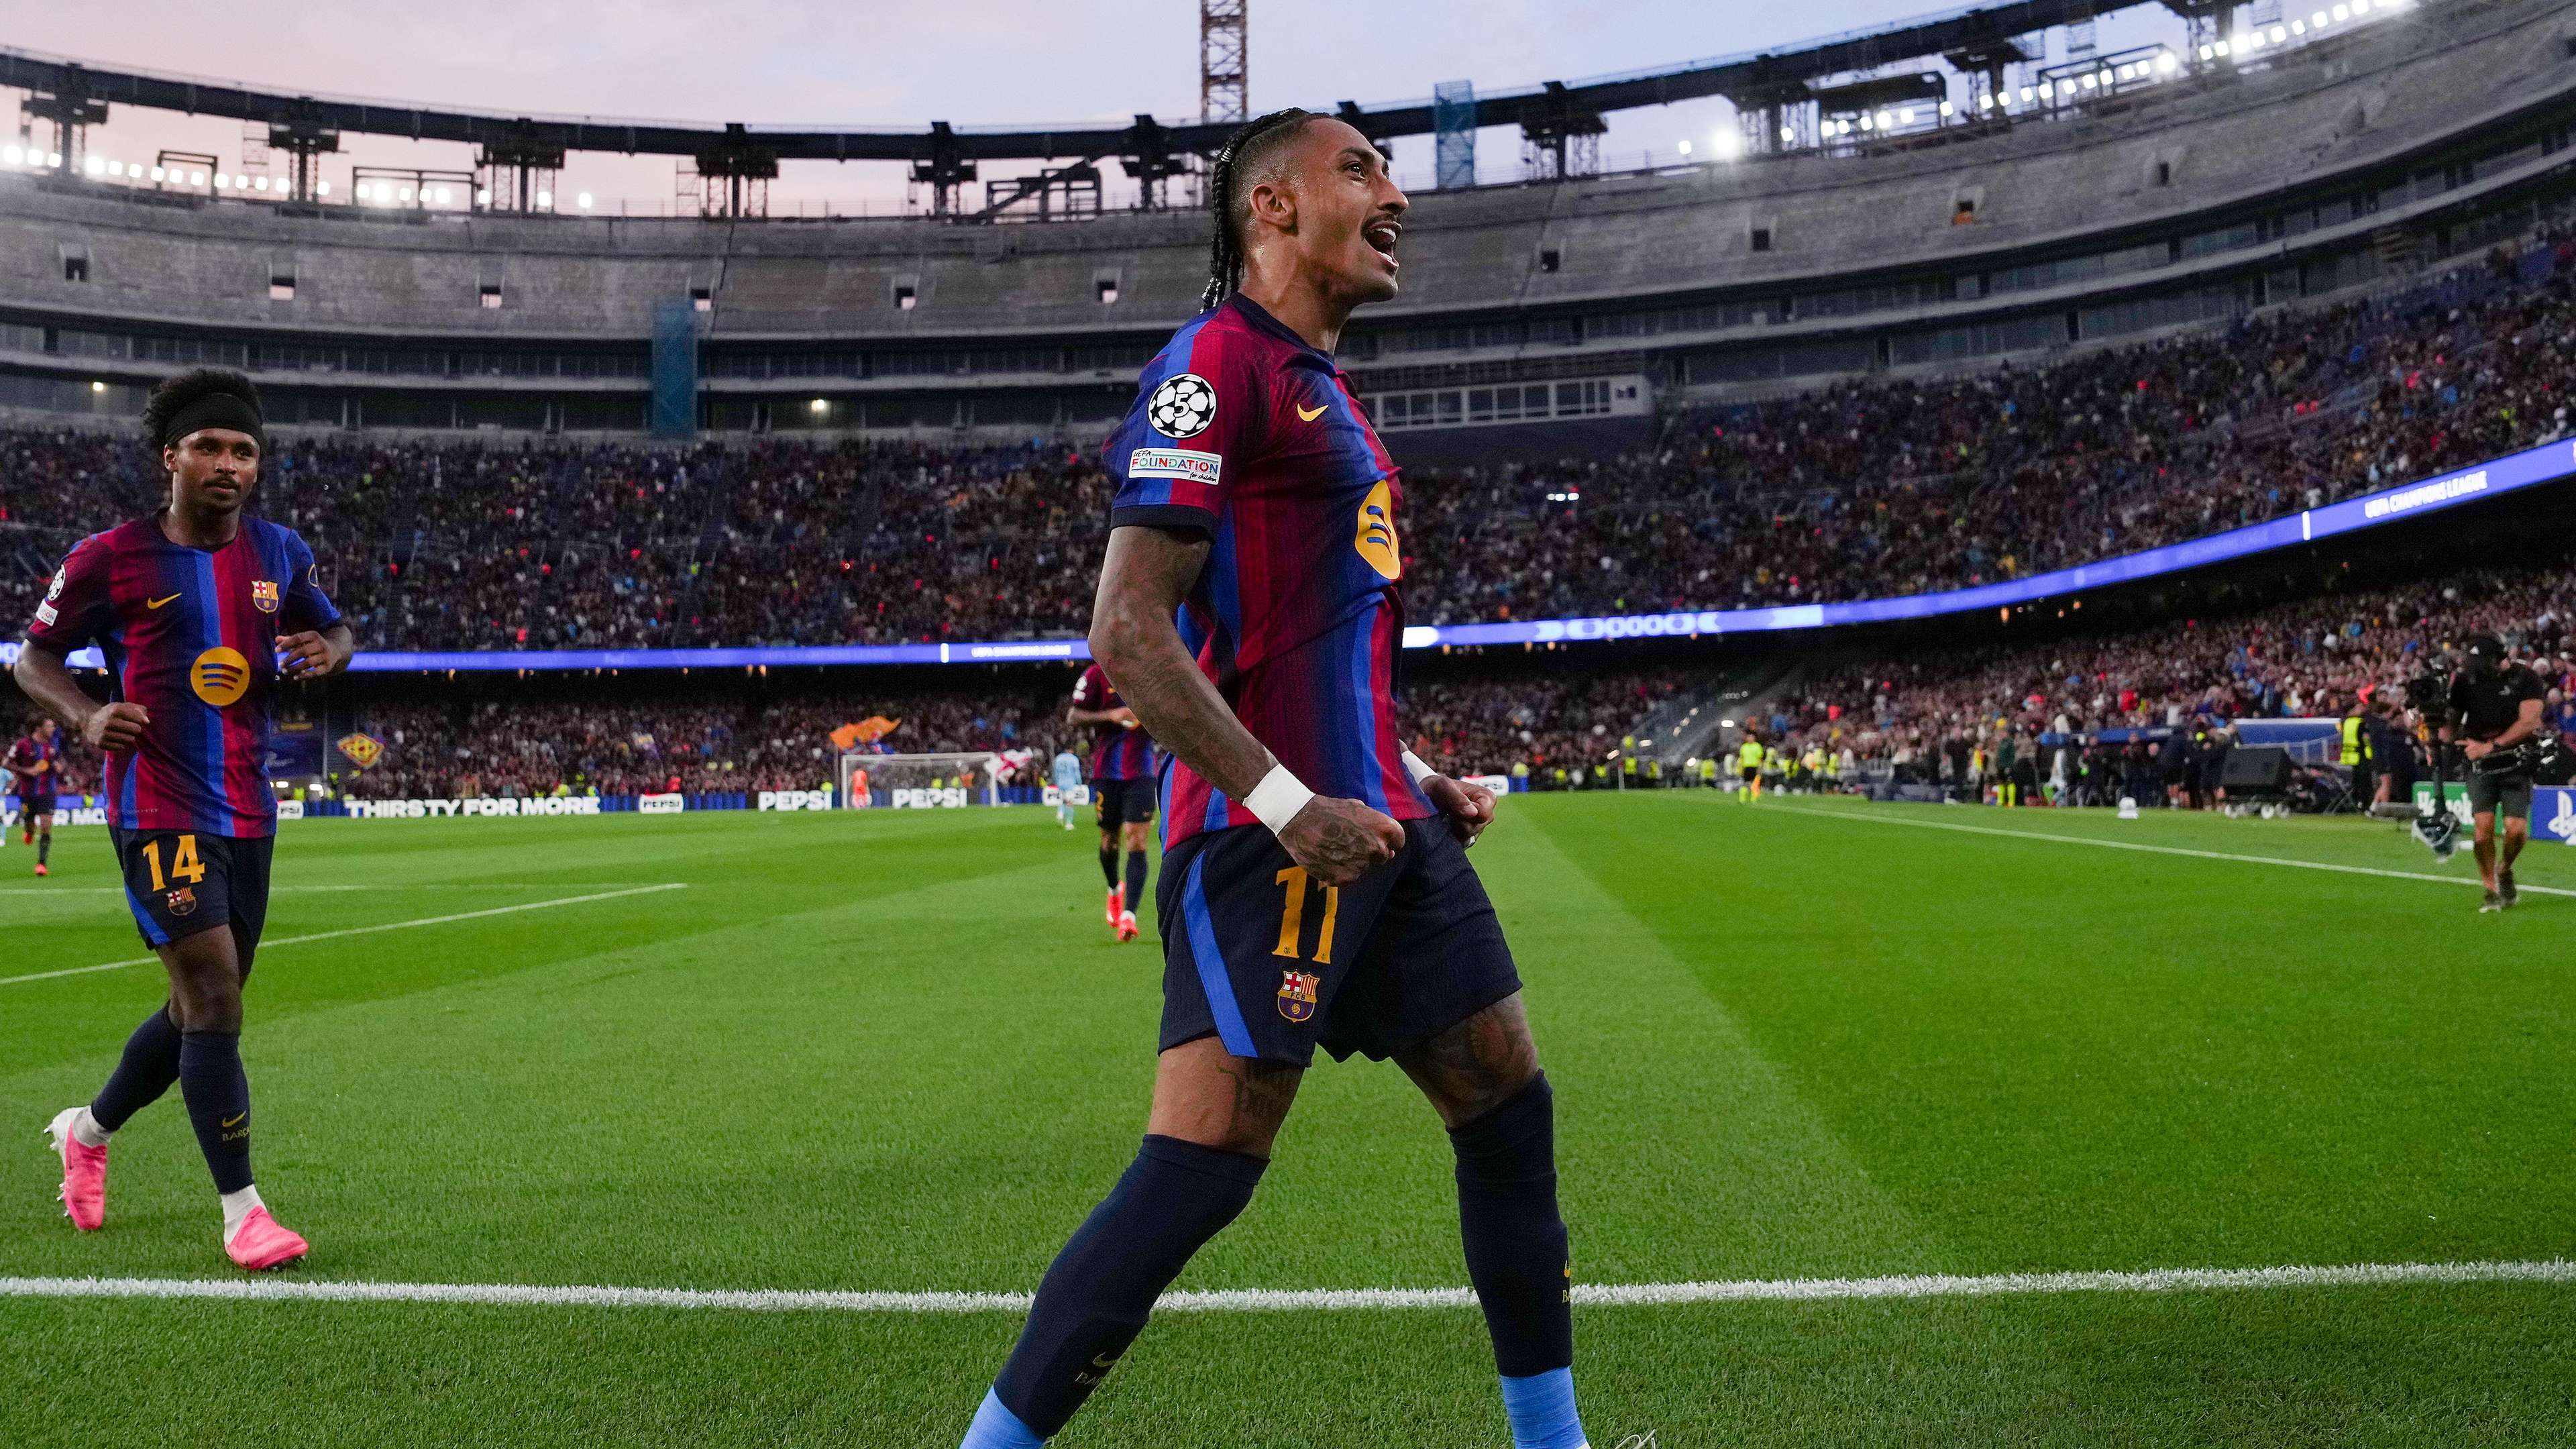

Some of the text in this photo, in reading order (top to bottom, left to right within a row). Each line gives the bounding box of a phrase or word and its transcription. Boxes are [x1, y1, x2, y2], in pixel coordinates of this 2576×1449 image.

[1174, 393, 1189, 417] 5
[1198, 474, 1216, 482] children
[344, 796, 600, 818] THIRSTY FOR MORE
[758, 790, 833, 811] PEPSI
[895, 788, 968, 808] PEPSI
[143, 835, 205, 892] 14
[1272, 865, 1338, 964] 11
[1291, 992, 1305, 1000] FCB
